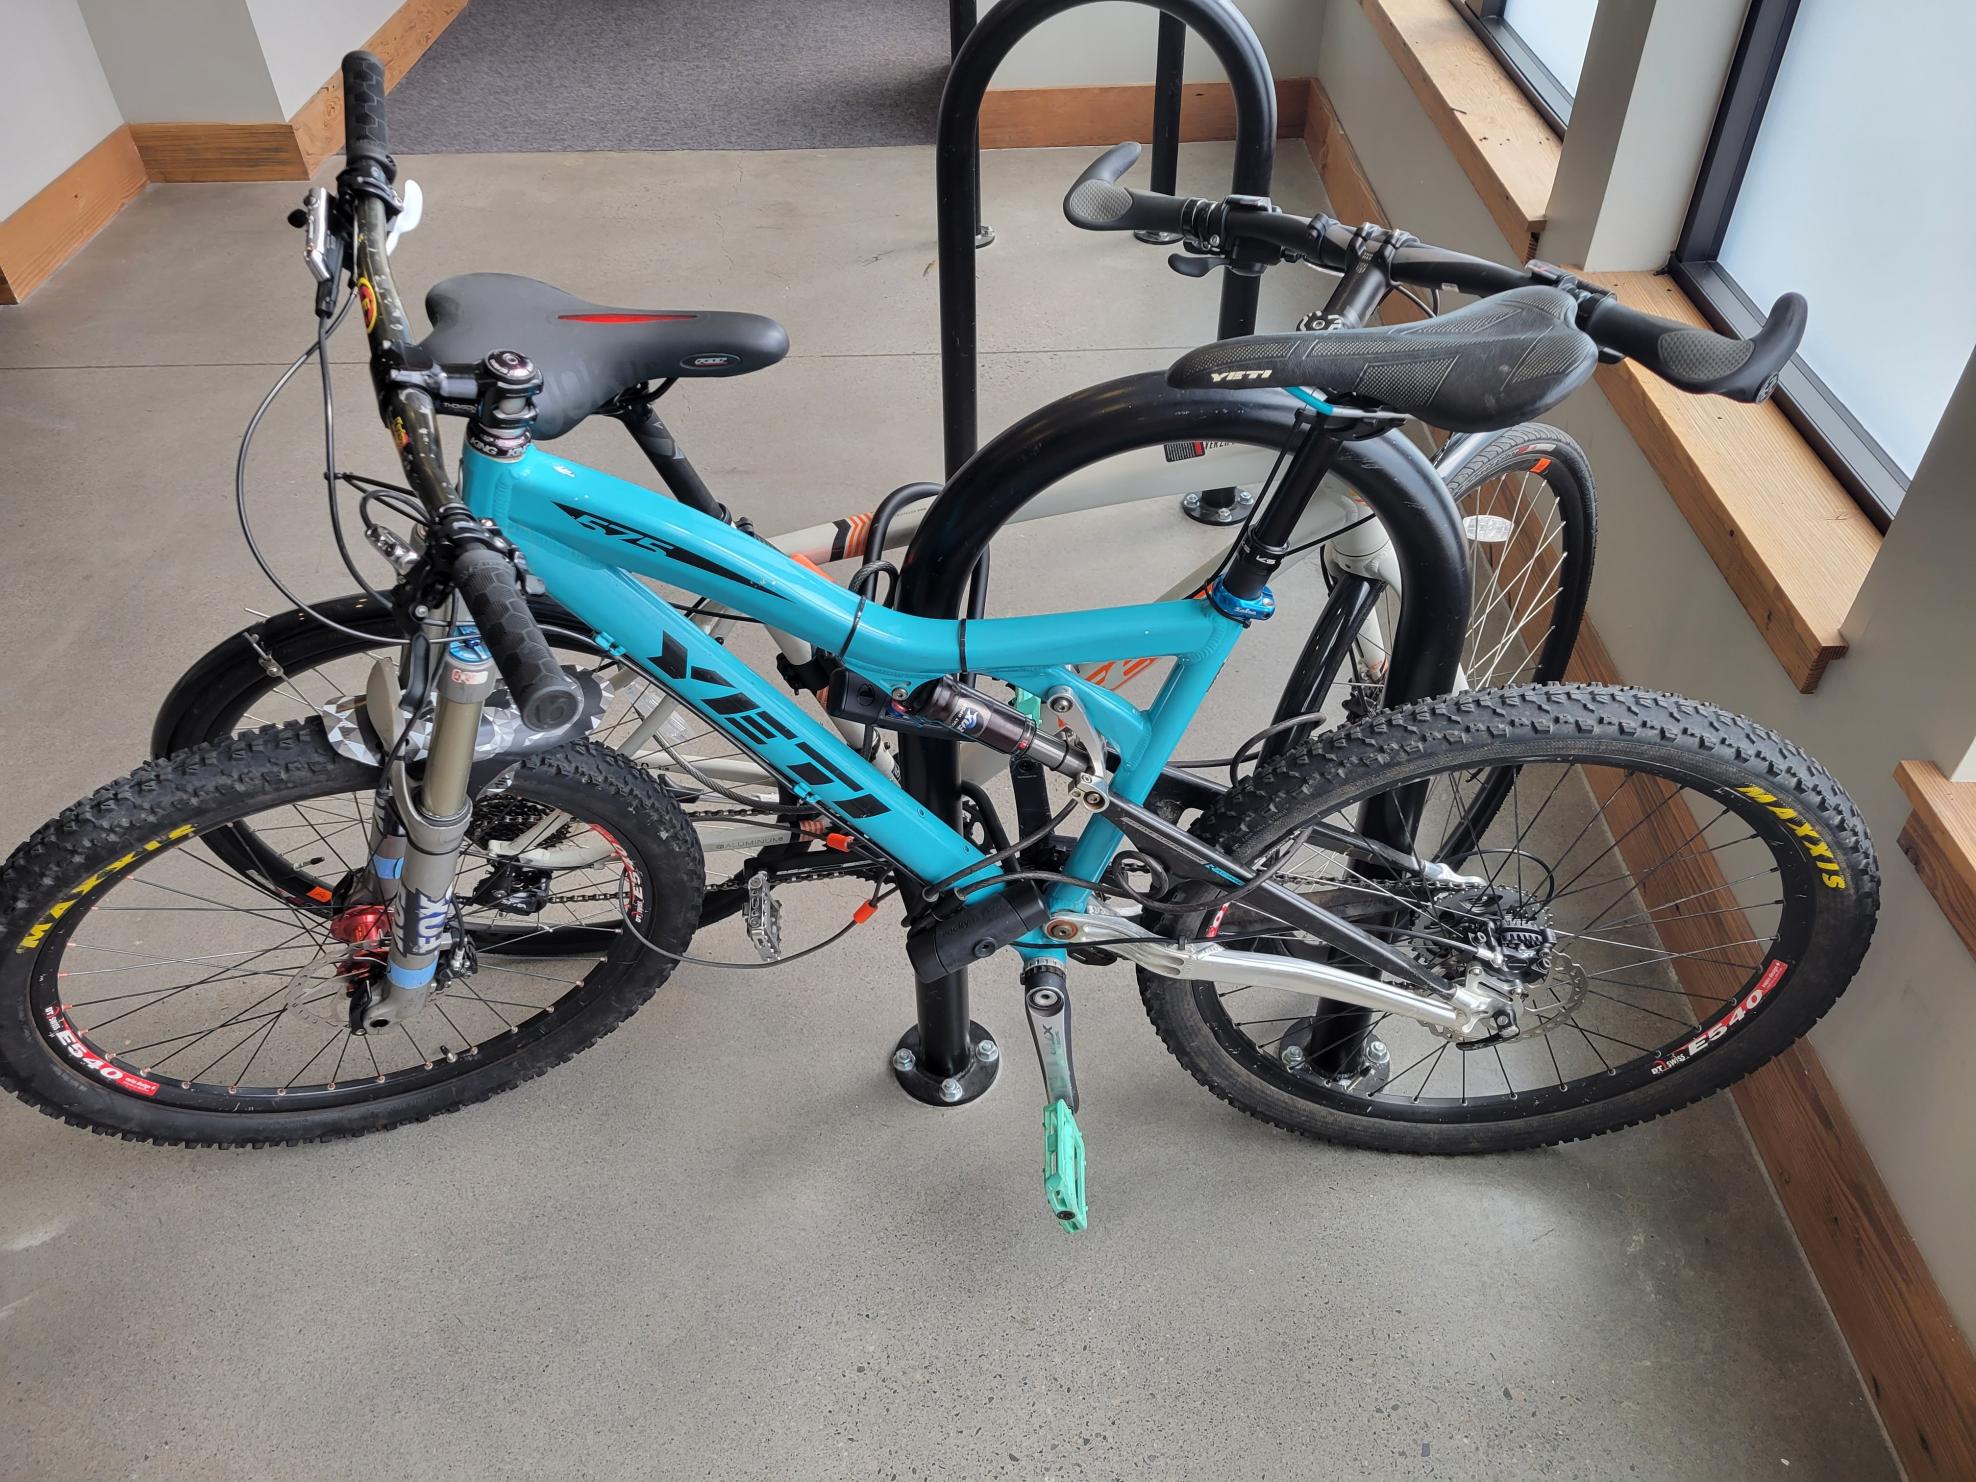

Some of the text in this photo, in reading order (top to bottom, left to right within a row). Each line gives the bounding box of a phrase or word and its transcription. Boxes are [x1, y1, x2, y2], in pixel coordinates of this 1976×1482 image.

[1211, 369, 1273, 383] YETI
[470, 437, 499, 455] KING
[571, 513, 677, 559] 575
[647, 630, 891, 819] YETI
[1734, 785, 1846, 890] MAXXIS
[19, 823, 197, 949] MAXXIS
[417, 890, 451, 955] FOX
[55, 1029, 124, 1080] E540
[1650, 1064, 1664, 1076] DT
[1666, 1053, 1686, 1070] SWISS
[1688, 989, 1764, 1057] E540
